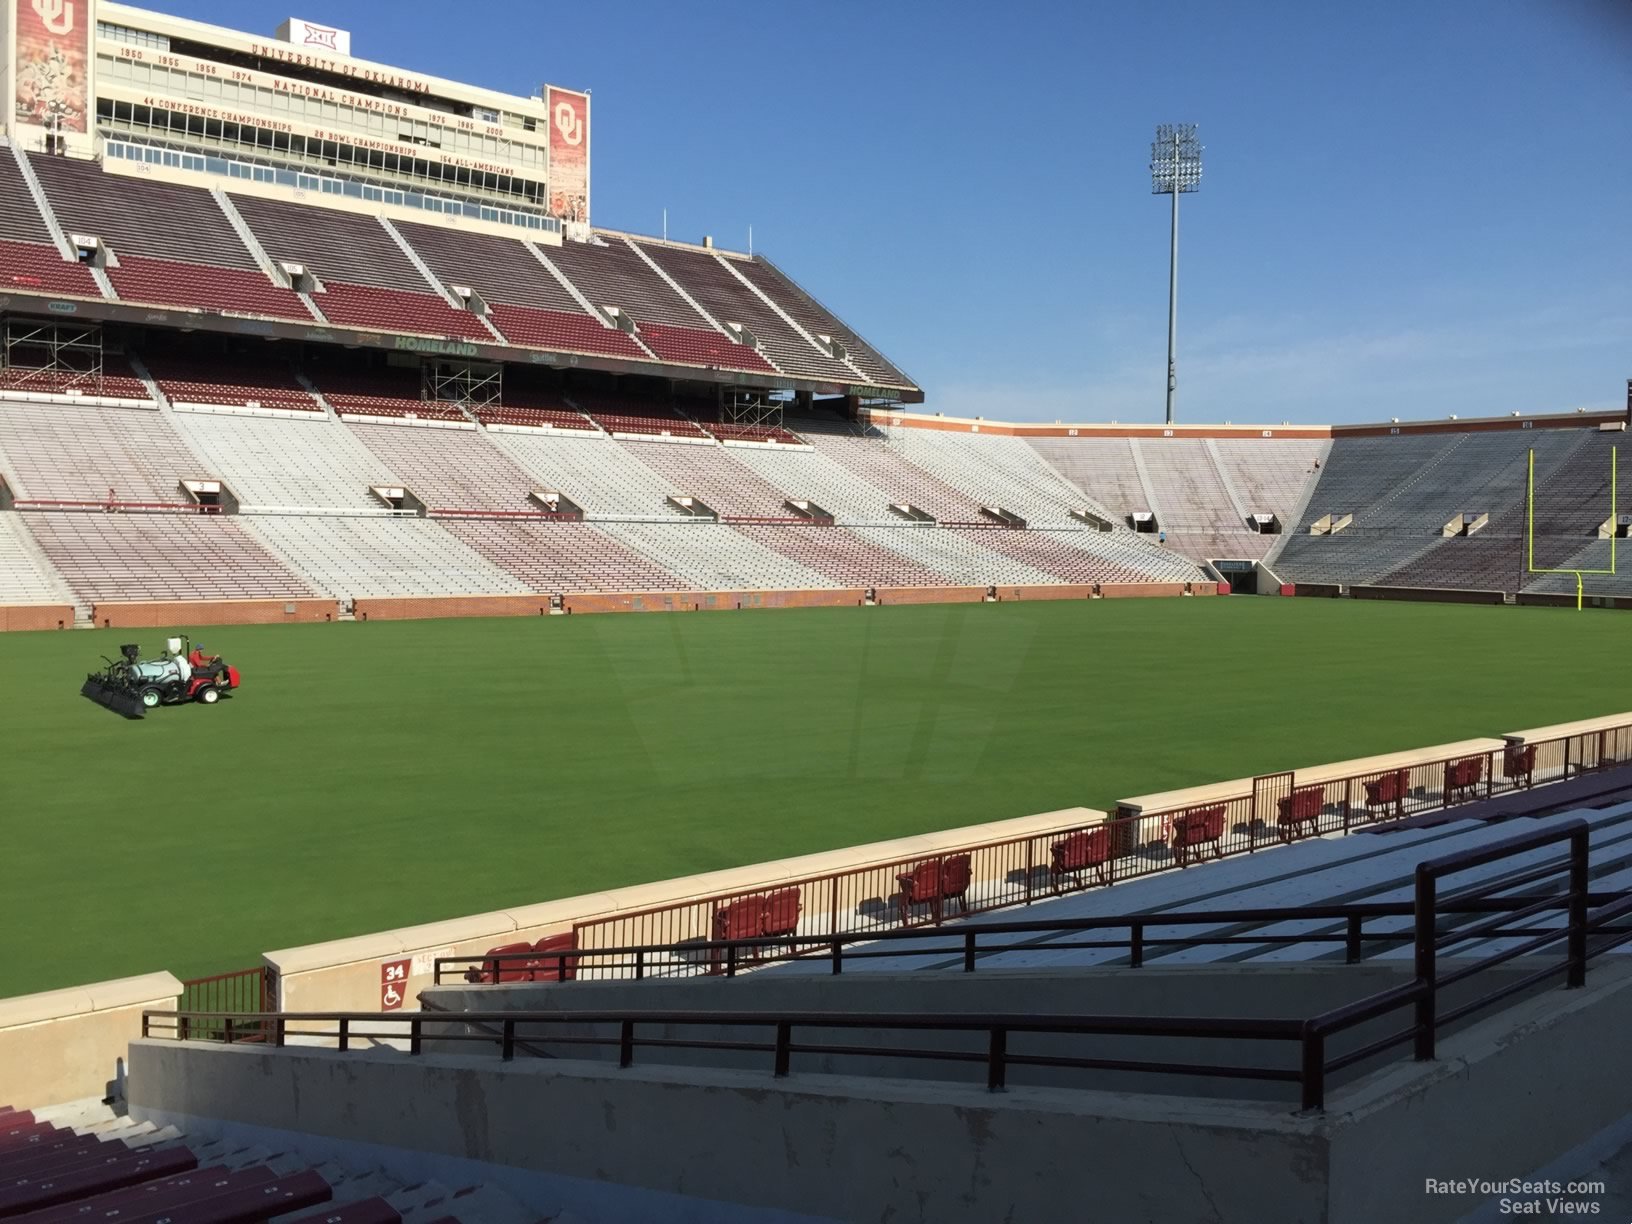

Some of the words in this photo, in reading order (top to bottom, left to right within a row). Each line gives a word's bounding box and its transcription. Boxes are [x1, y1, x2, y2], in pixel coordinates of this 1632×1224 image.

[121, 47, 143, 60] 1950
[158, 55, 180, 68] 1955
[196, 63, 217, 75] 1956
[231, 70, 252, 83] 1974
[252, 43, 336, 72] UNIVERSITY
[343, 65, 357, 77] OF
[365, 70, 430, 94] OKLAHOMA
[274, 80, 335, 101] NATIONAL
[342, 94, 408, 117] CHAMPIONS
[143, 96, 154, 107] 44
[159, 99, 218, 119] CONFERENCE
[221, 111, 292, 132] CHAMPIONSHIPS
[555, 102, 582, 146] OU
[429, 113, 446, 125] 1975
[486, 126, 504, 137] 2000
[314, 129, 324, 139] 28
[329, 132, 351, 144] BOWL
[354, 137, 417, 157] CHAMPIONSHIPS
[455, 156, 514, 176] ALL-AMERICANS
[78, 236, 91, 246] 104
[287, 264, 298, 273] 105
[50, 302, 76, 312] KRAFT
[395, 336, 477, 357] HOMELAND
[850, 385, 901, 400] HOMELAND
[200, 482, 205, 492] 3
[385, 488, 392, 497] 4
[386, 964, 404, 981] 34
